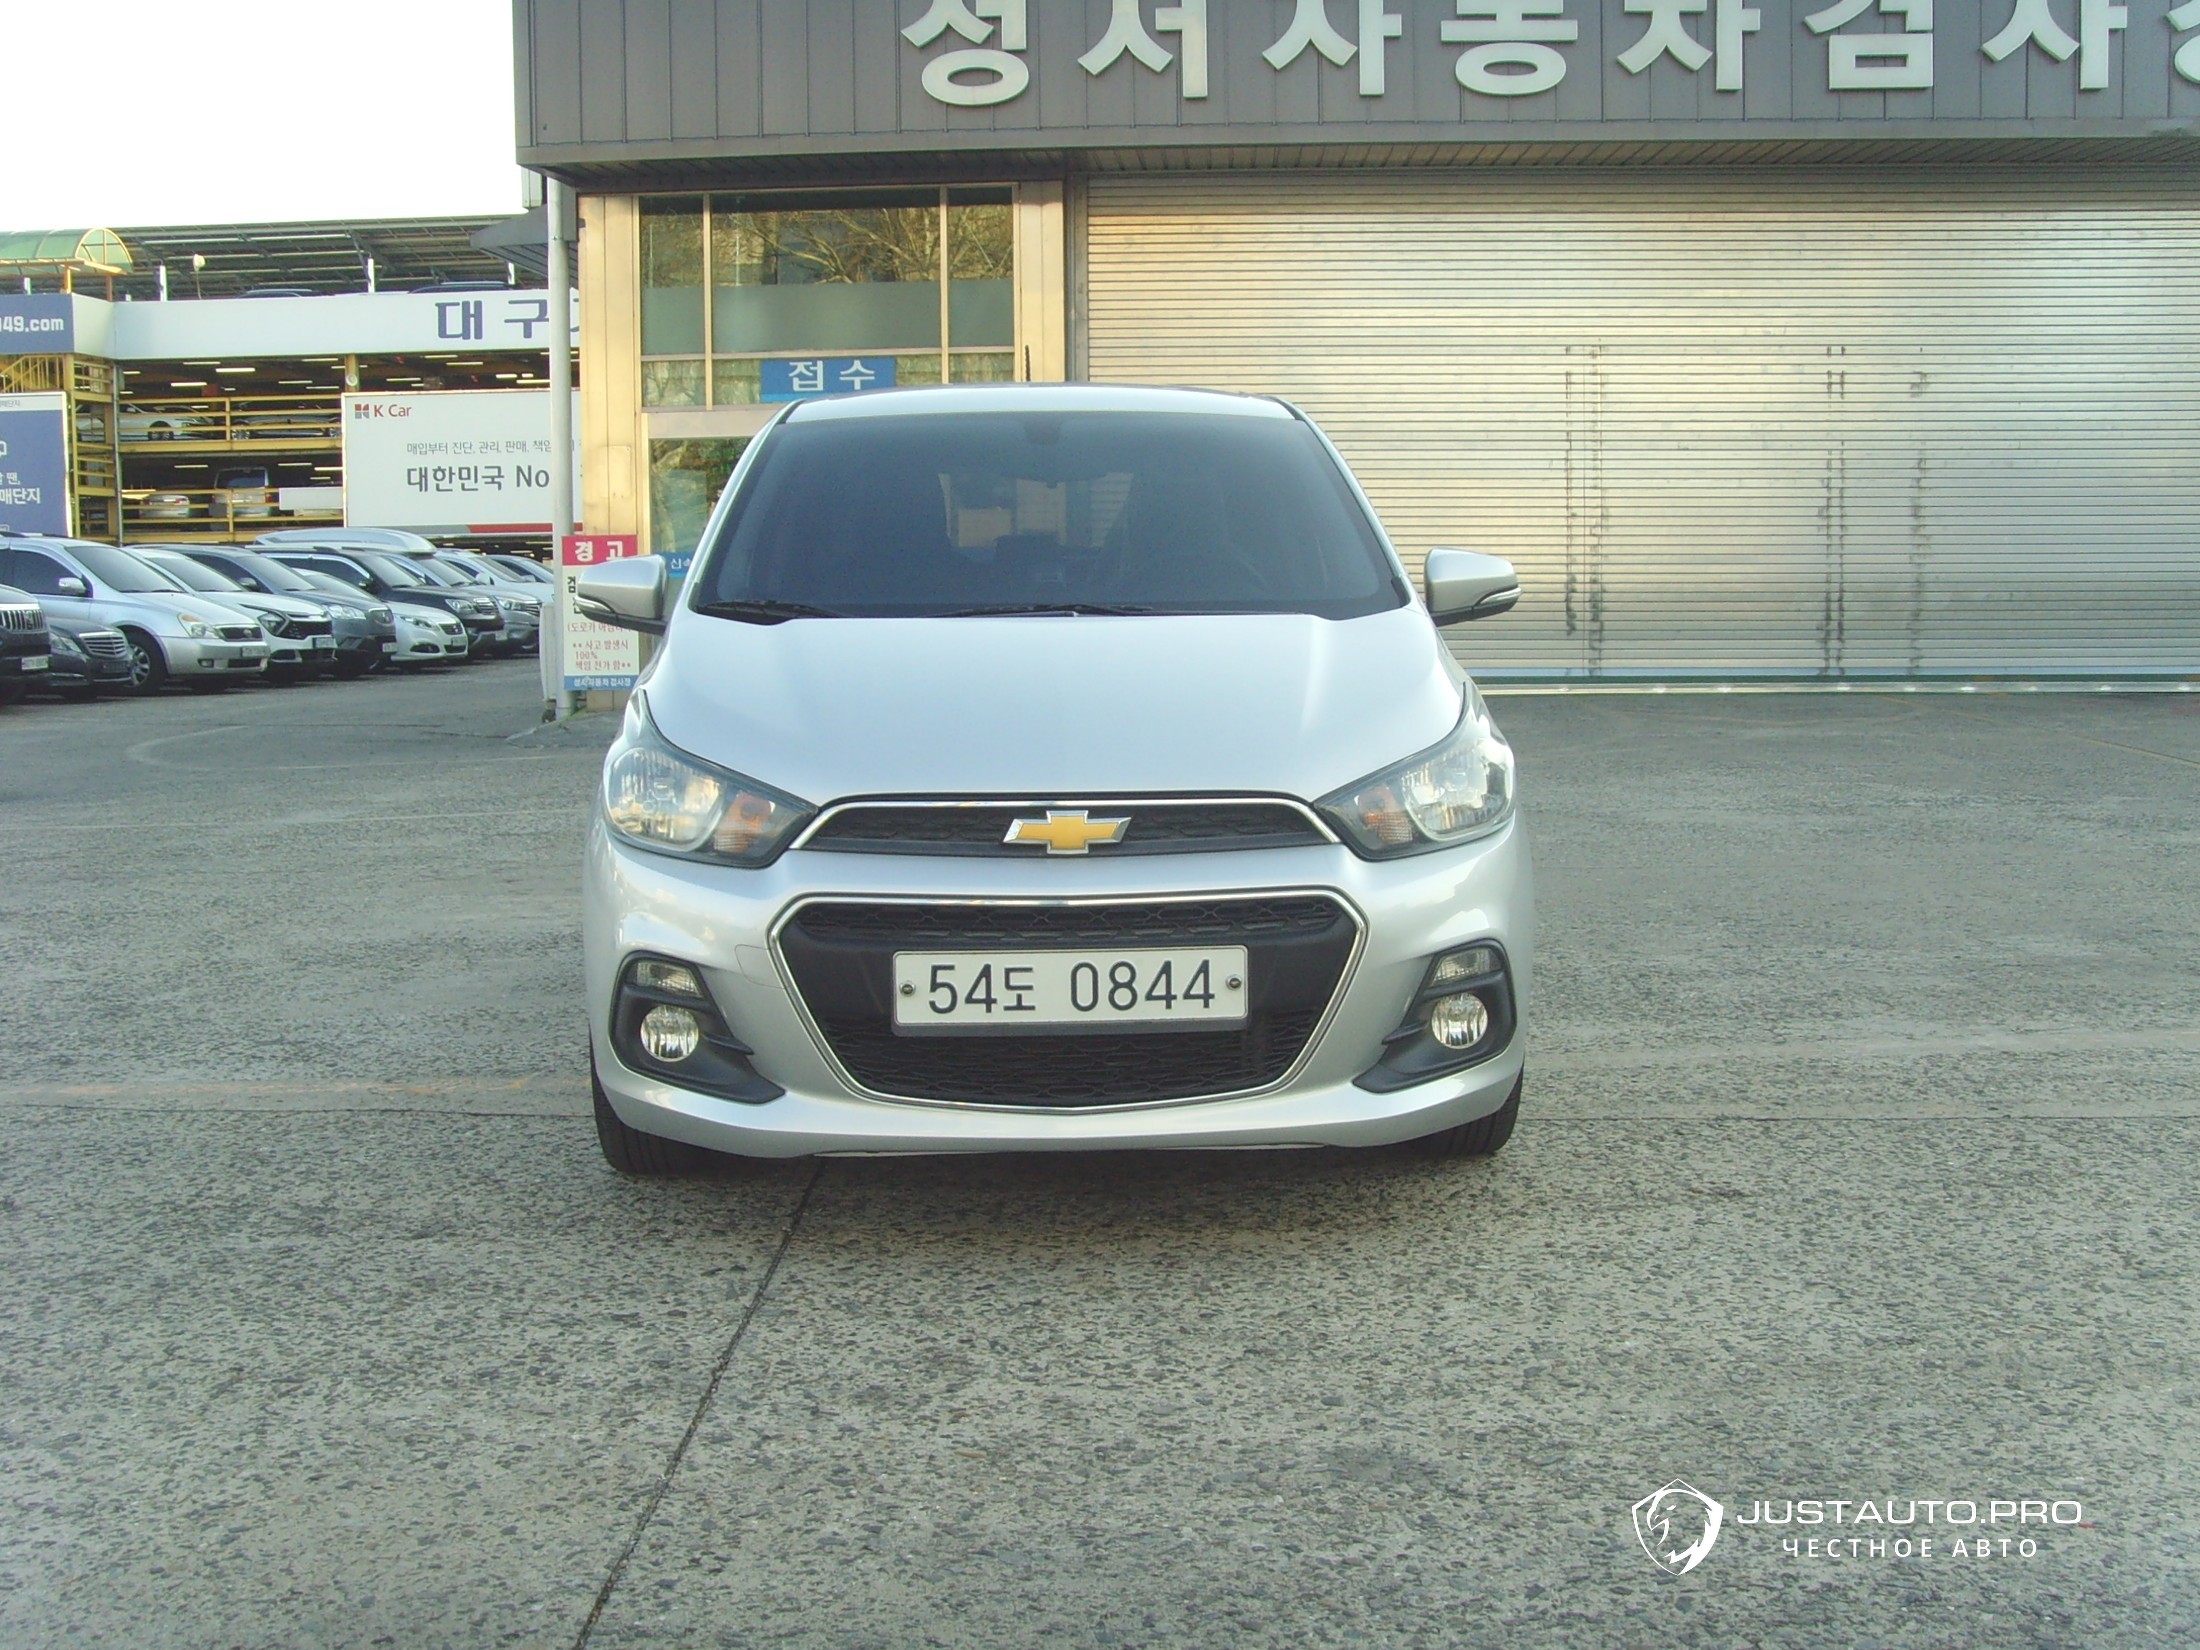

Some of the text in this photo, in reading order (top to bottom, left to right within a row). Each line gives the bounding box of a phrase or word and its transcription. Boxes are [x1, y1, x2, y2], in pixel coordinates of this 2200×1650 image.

[900, 0, 2200, 106] 성서자동차검사
[0, 315, 64, 333] 49.com
[434, 299, 580, 341] 대구
[787, 359, 876, 392] 접수
[373, 403, 412, 418] K Car
[406, 441, 448, 456] 매입부터
[406, 465, 505, 493] 대한민국
[575, 540, 623, 562] 경고
[575, 651, 598, 660] 100%
[928, 959, 1216, 1014] 54도 0844
